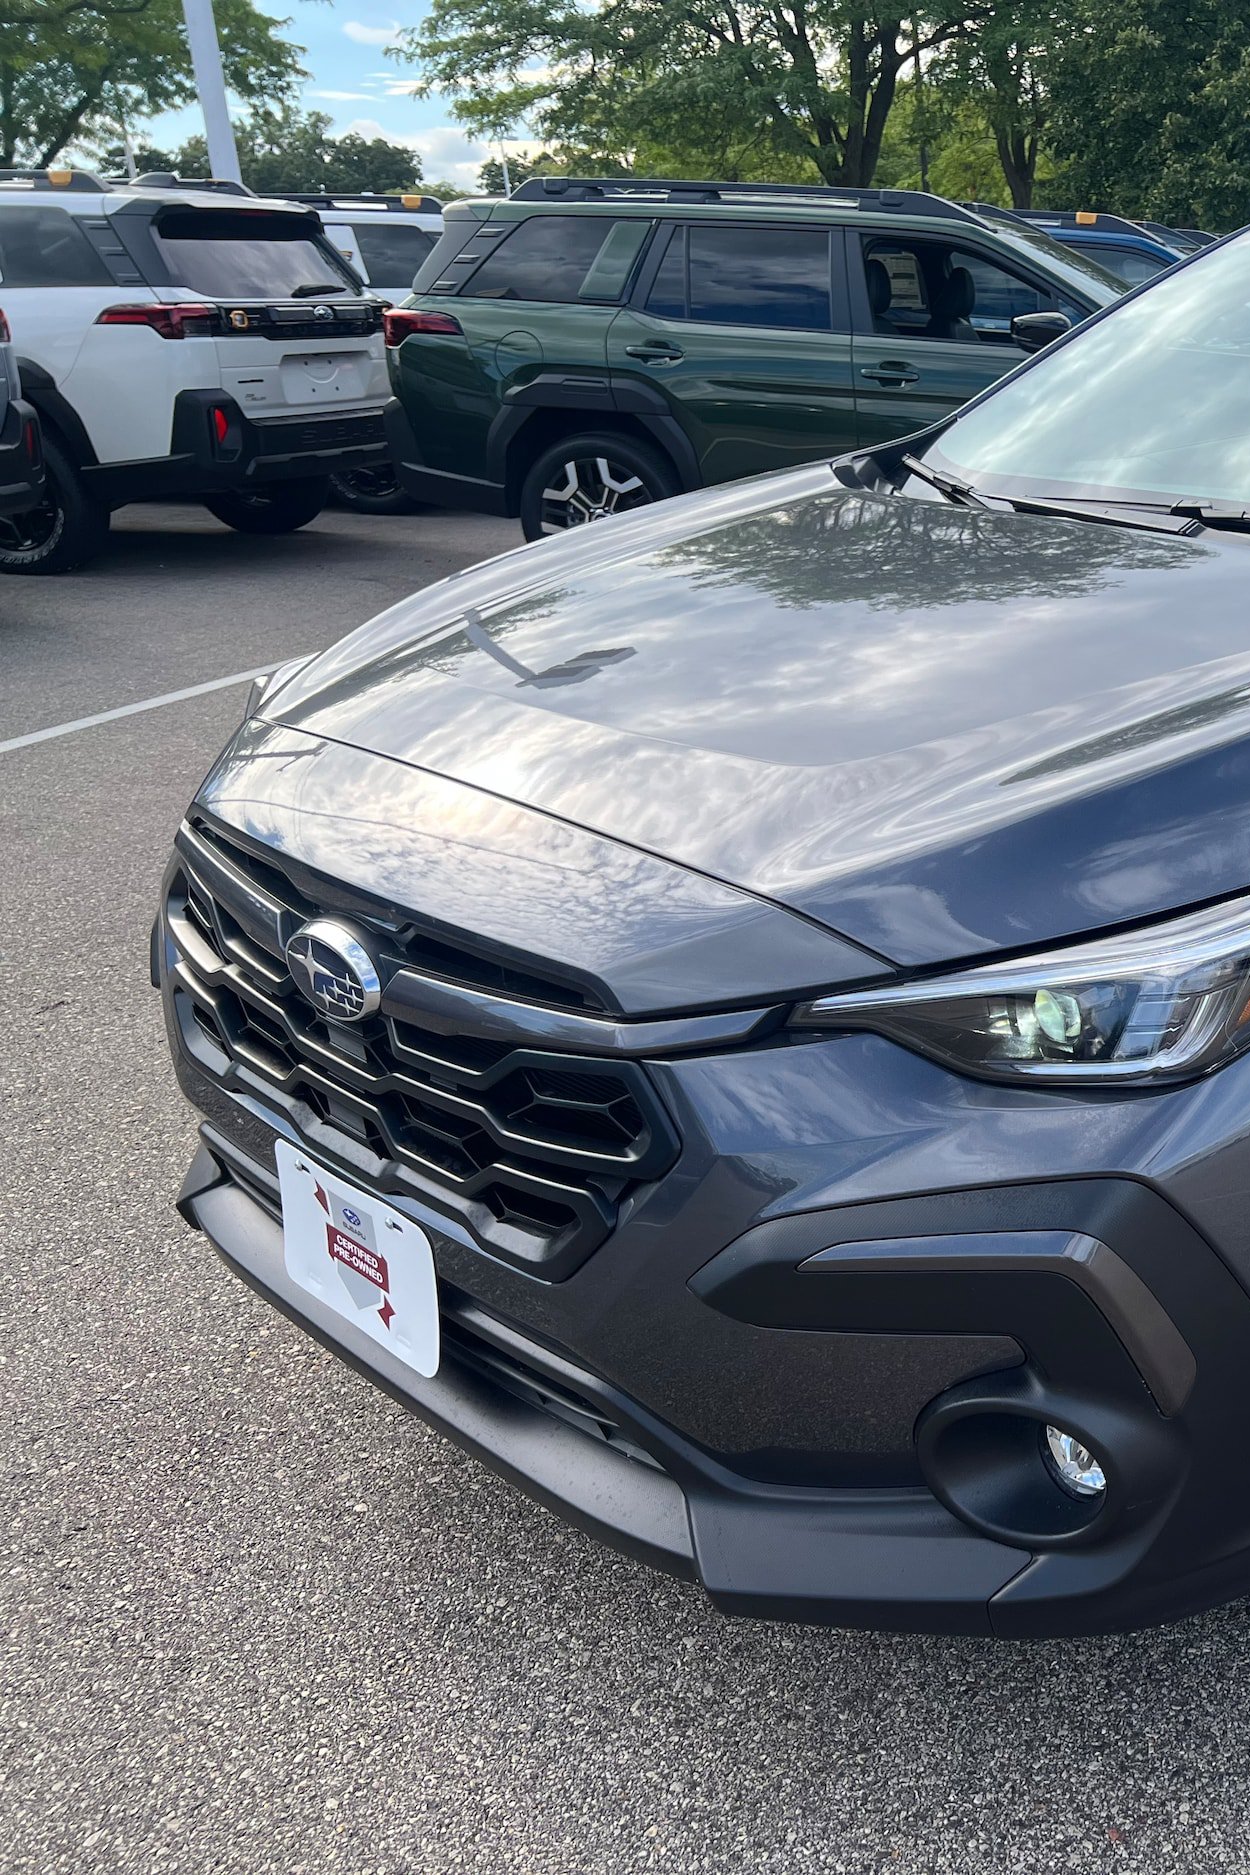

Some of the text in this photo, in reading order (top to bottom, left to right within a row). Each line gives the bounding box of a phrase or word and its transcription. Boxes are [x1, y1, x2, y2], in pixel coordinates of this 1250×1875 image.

[343, 1221, 366, 1240] SUBARU
[333, 1243, 383, 1284] PRE-OWNED
[336, 1234, 379, 1269] CERTIFIED
